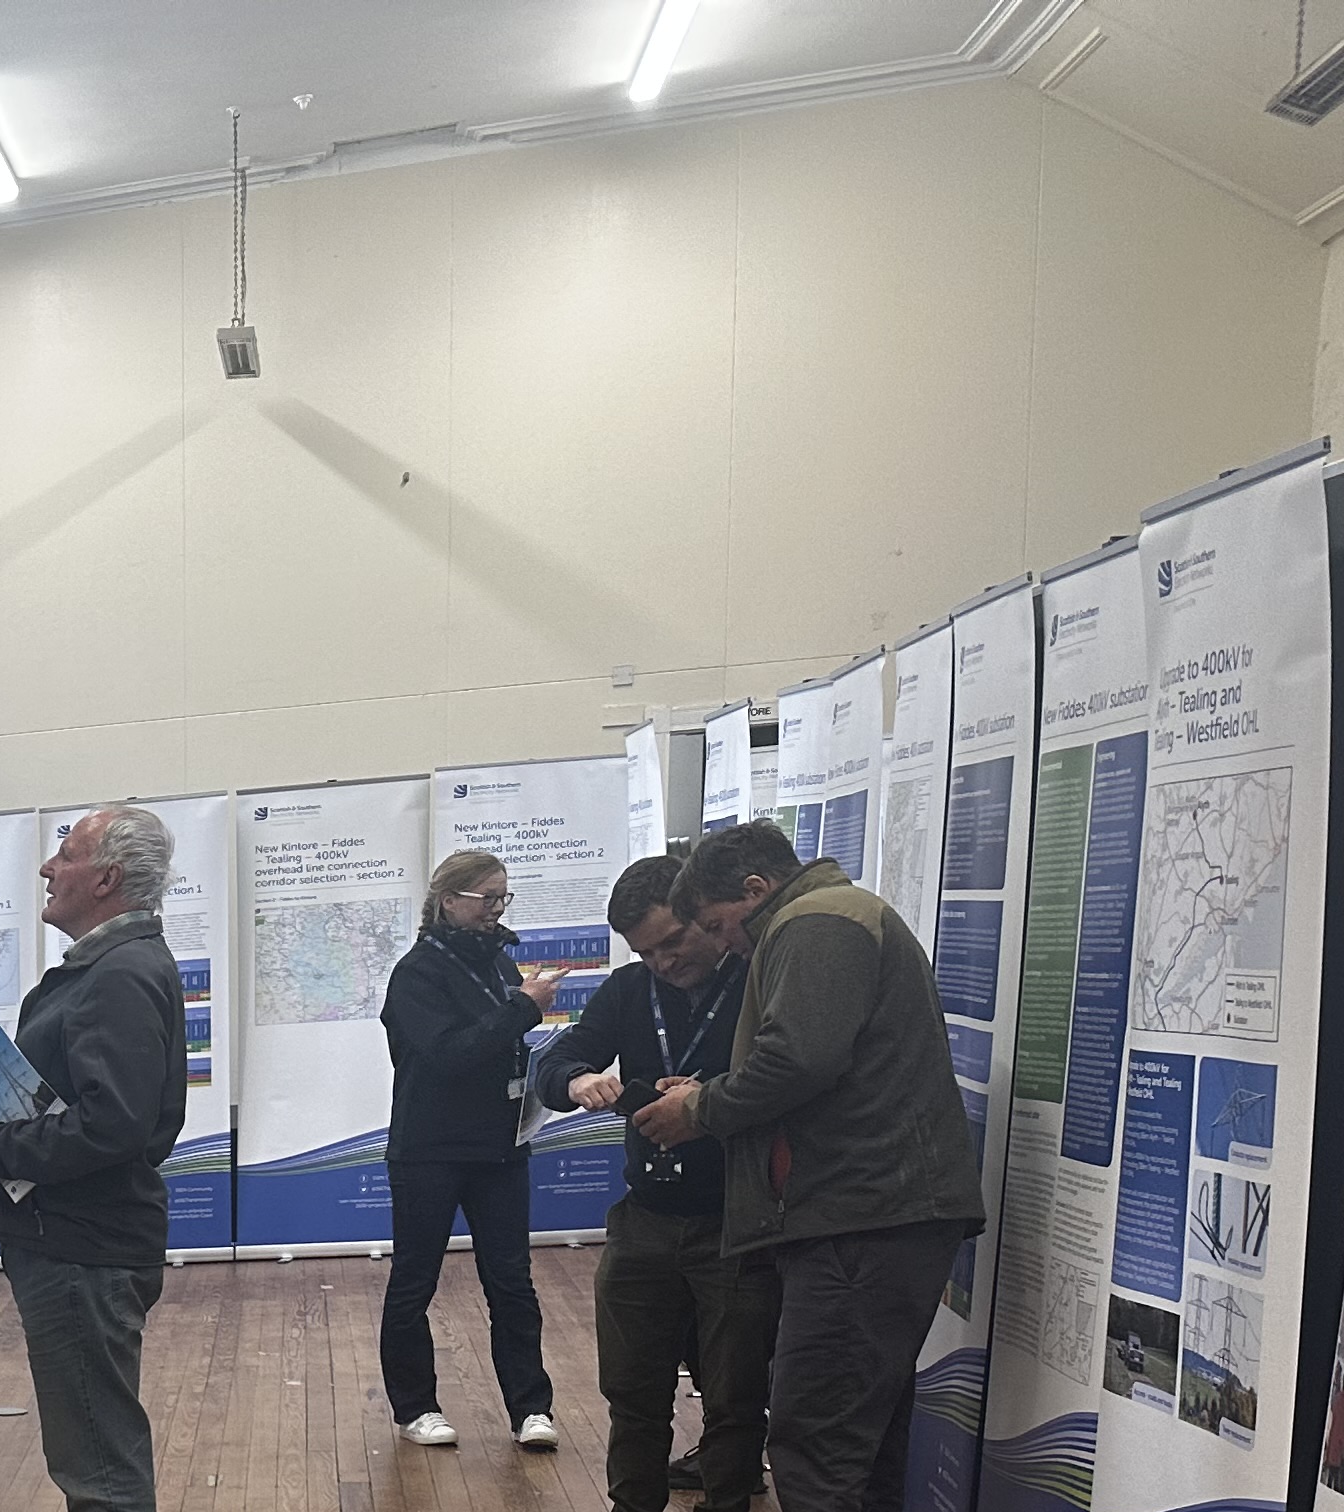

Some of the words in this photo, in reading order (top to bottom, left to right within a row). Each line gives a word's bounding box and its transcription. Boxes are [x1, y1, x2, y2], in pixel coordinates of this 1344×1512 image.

[1188, 659, 1198, 680] to
[1202, 646, 1240, 676] 400kV
[1242, 643, 1254, 668] for
[1178, 690, 1217, 714] Tealing
[1220, 680, 1242, 706] and
[750, 707, 772, 716] ORE
[1058, 698, 1086, 720] Fiddes
[1087, 690, 1108, 715] 400kV
[1187, 712, 1238, 746] Westfield
[1242, 708, 1260, 736] OHL
[753, 808, 777, 816] Kint
[454, 824, 478, 832] New
[481, 821, 518, 830] Kintore
[531, 817, 564, 827] Fiddes
[464, 834, 501, 843] Tealing
[514, 829, 548, 839] 400kV
[255, 845, 278, 854] New
[281, 842, 318, 851] Kintore
[332, 838, 365, 847] Fiddes
[506, 844, 524, 852] line
[527, 839, 587, 850] connection
[265, 854, 301, 864] Tealing
[315, 850, 348, 860] 400kV
[556, 850, 594, 860] section
[597, 848, 603, 857] 2
[254, 863, 303, 876] overhead
[306, 864, 324, 872] line
[327, 859, 387, 870] connection
[255, 877, 297, 887] corridor
[299, 874, 346, 884] selection
[356, 870, 394, 880] section
[397, 868, 404, 877] 2
[5, 900, 11, 909] 1
